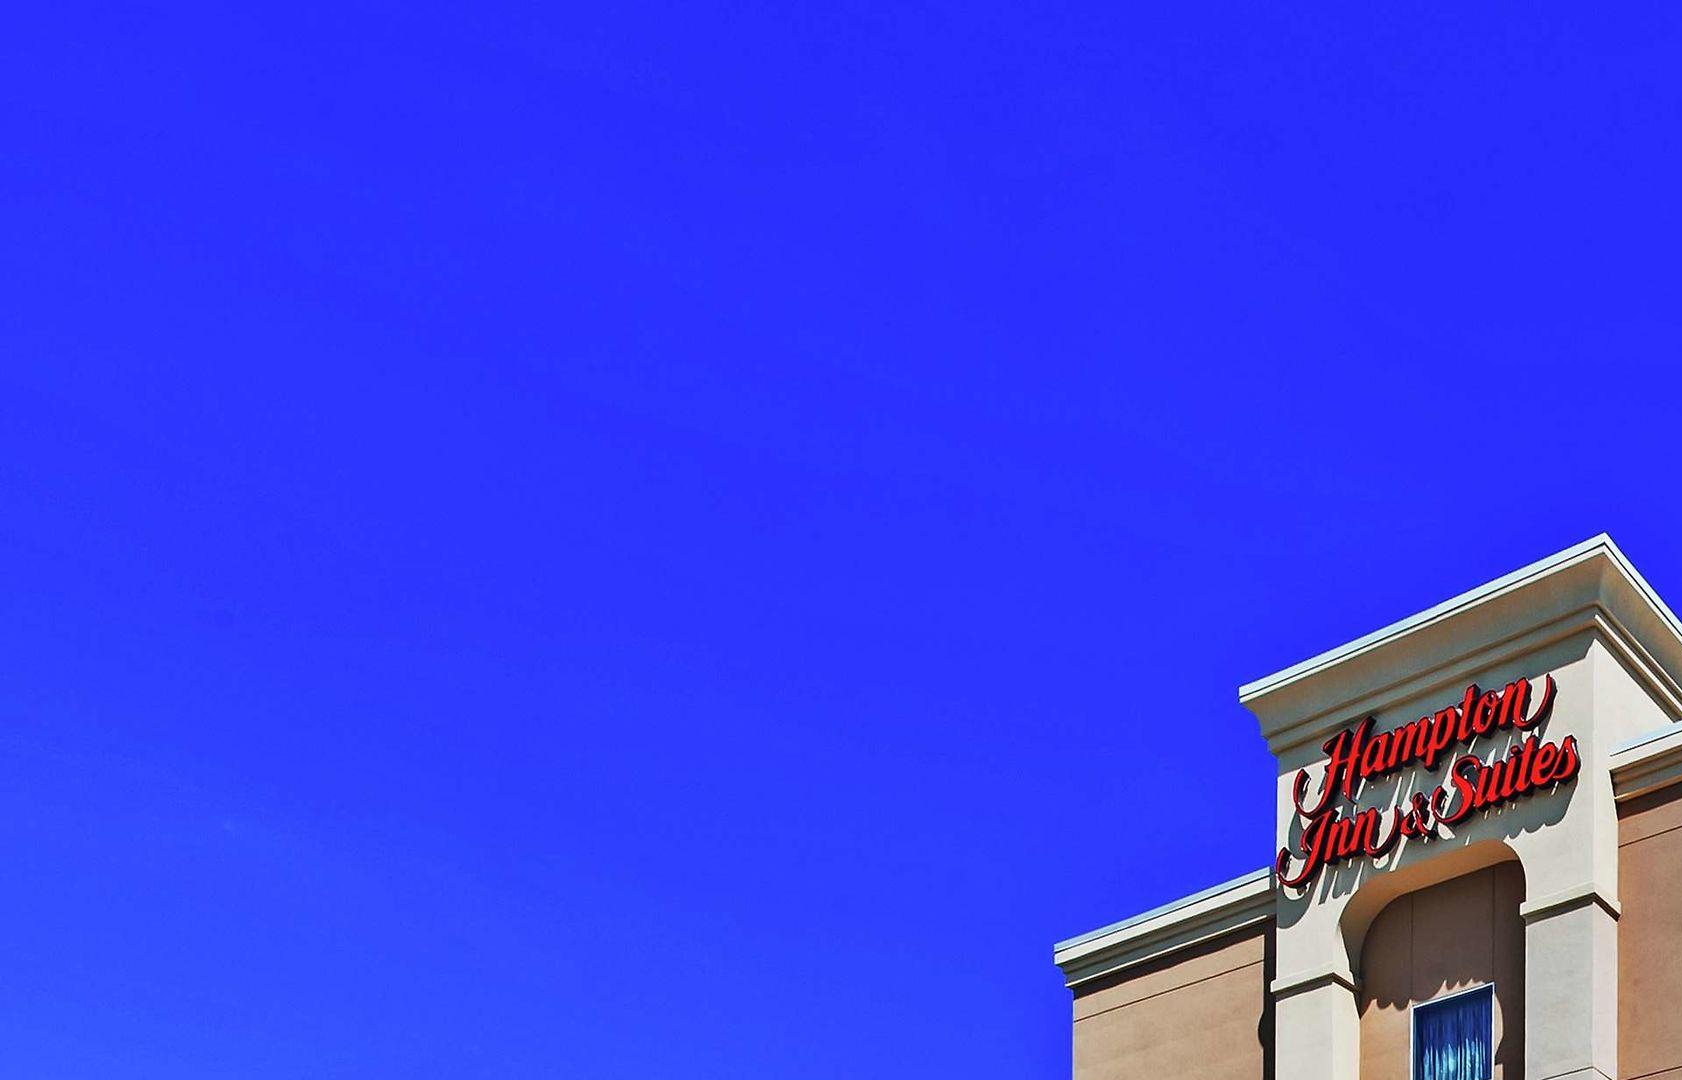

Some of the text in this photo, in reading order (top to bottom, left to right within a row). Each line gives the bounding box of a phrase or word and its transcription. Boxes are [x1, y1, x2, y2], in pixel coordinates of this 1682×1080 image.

[1276, 735, 1581, 888] Inn & Suites
[1293, 673, 1557, 820] Hampton
